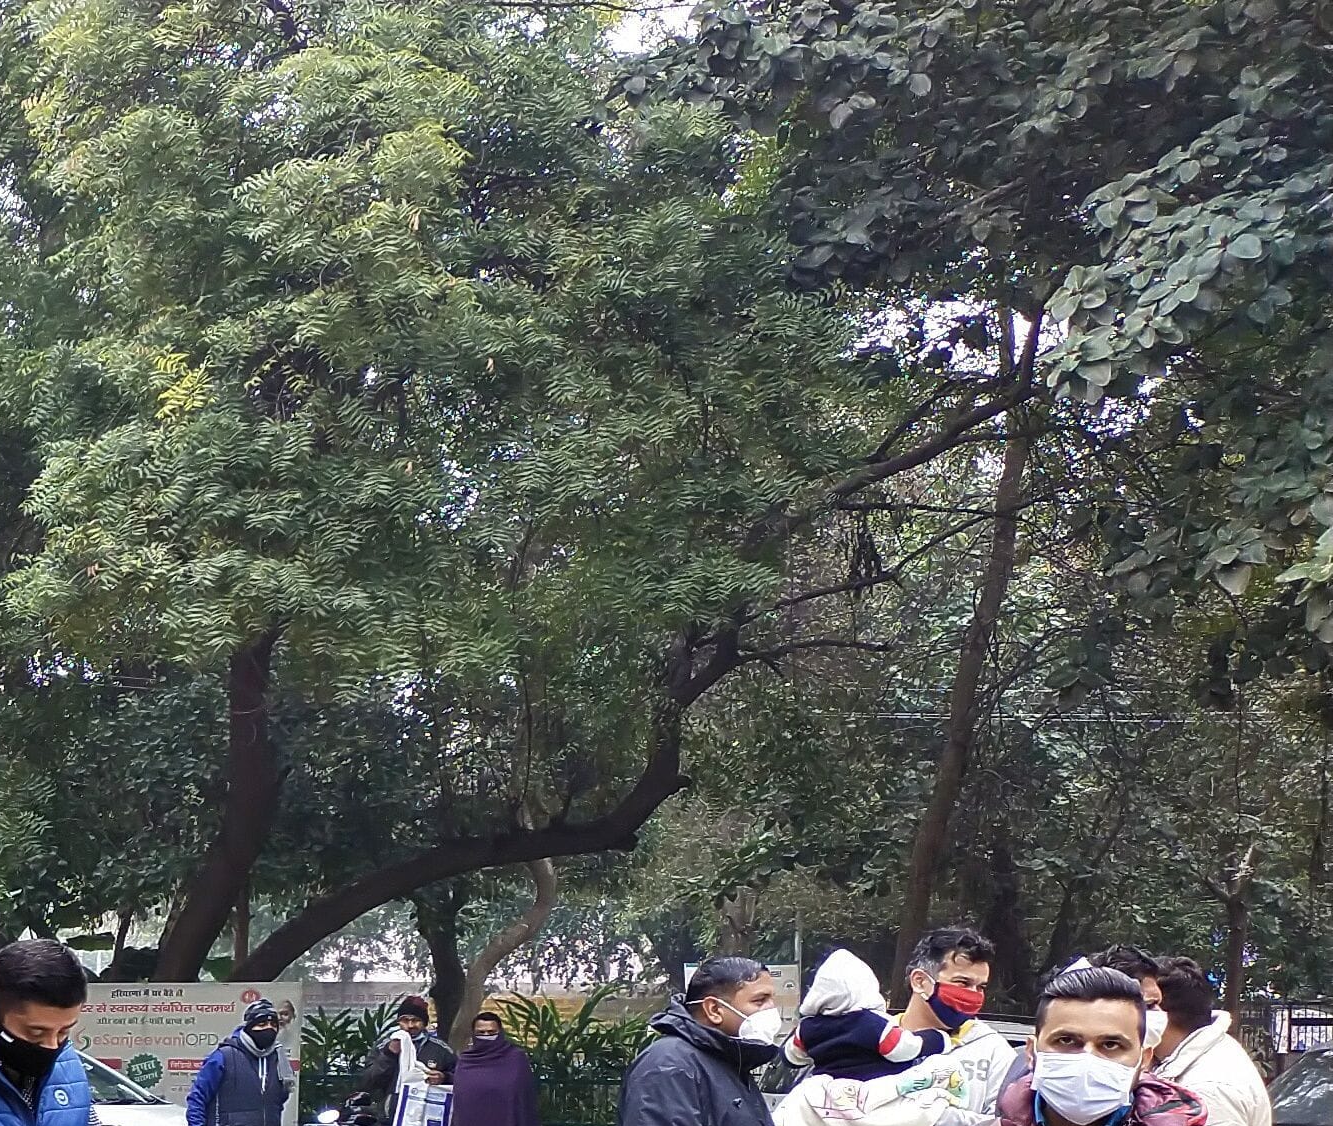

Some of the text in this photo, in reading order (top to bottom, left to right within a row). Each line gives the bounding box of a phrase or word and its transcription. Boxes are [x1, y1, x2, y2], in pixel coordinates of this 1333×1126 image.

[81, 1004, 93, 1013] टर
[96, 1002, 106, 1013] से
[110, 1004, 149, 1013] स्वास्थ्य
[195, 1001, 236, 1013] परामर्श
[93, 1031, 219, 1048] eSanjeevaniOPD
